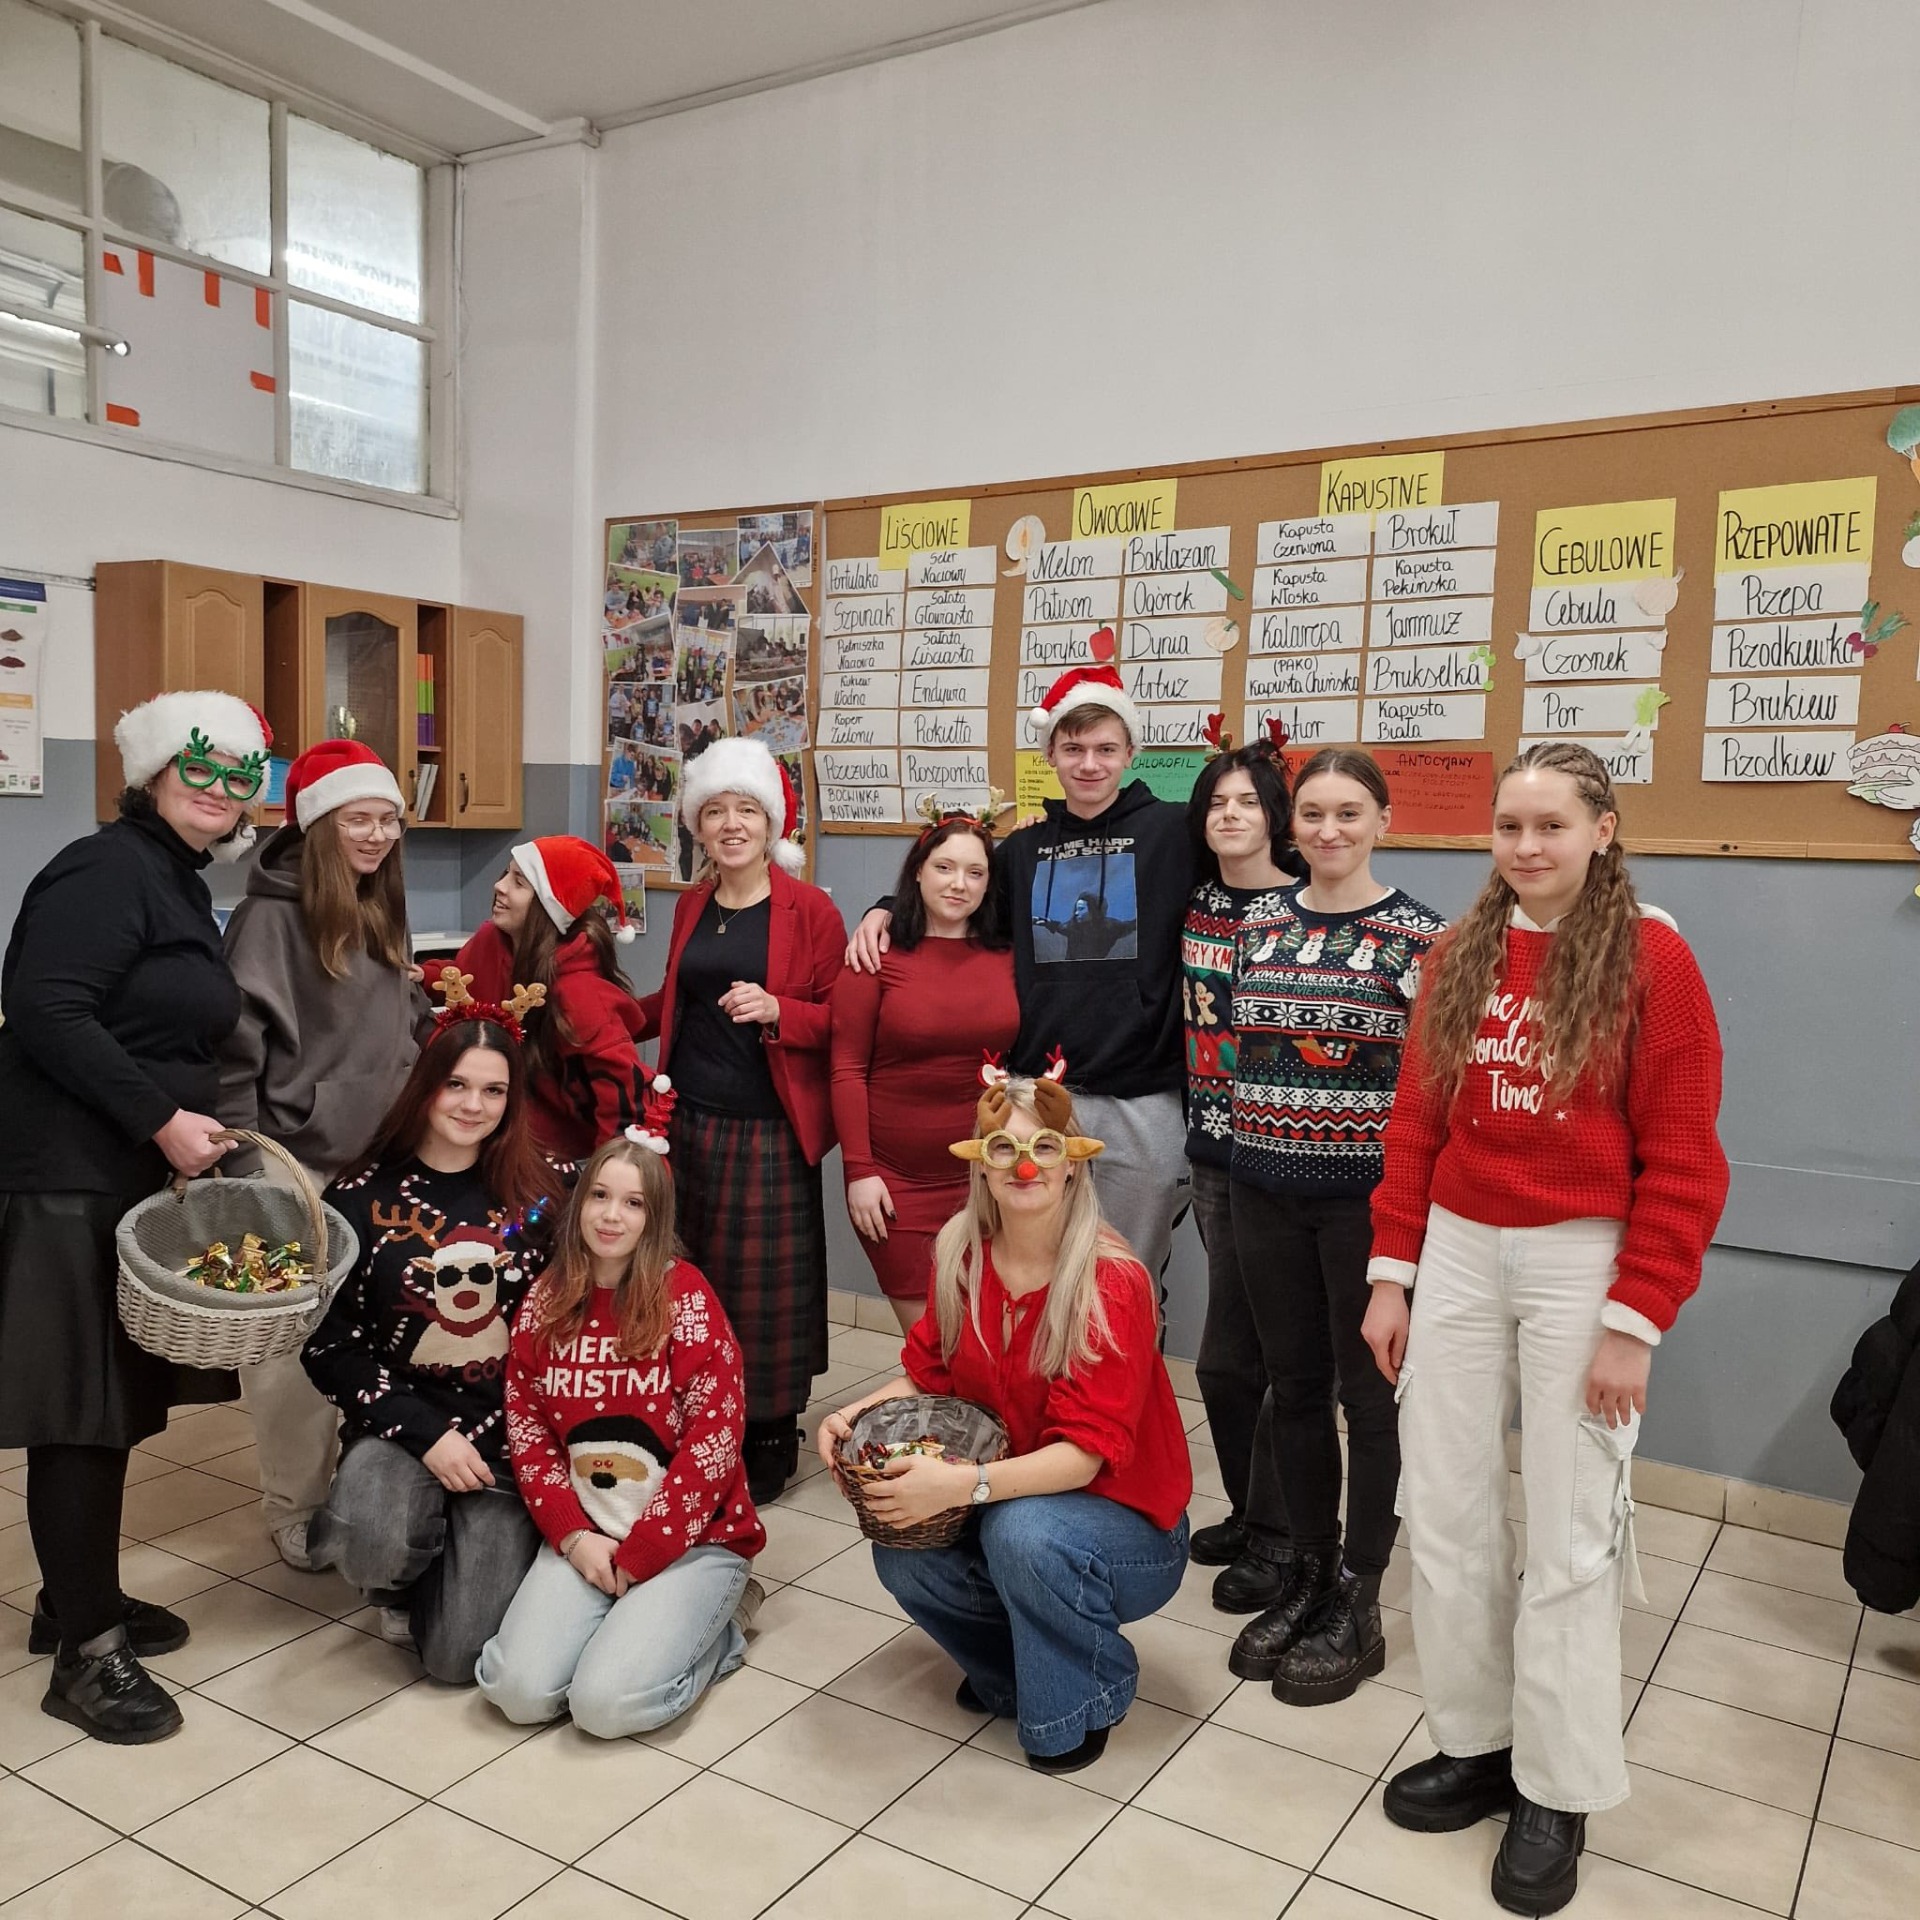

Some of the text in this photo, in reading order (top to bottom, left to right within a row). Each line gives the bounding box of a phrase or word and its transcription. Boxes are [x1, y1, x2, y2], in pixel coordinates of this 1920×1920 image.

[1326, 470, 1429, 514] KAPUSTNE
[1078, 492, 1163, 537] OWOCOWE
[1279, 518, 1335, 541] Kapusta
[1388, 509, 1461, 551] Brokuł
[1273, 539, 1337, 559] Czerwona
[1539, 527, 1664, 576] CEBULOWE
[1723, 510, 1861, 560] RZEPOWATE
[829, 562, 879, 590] Portulaka
[1032, 545, 1095, 580] Melon
[1272, 566, 1328, 588] Kapusta
[1395, 557, 1454, 579] Kapusta
[1134, 581, 1196, 616] Ogórek
[1271, 588, 1320, 606] Włoska
[1383, 574, 1459, 598] Pekińska
[1741, 575, 1824, 616] Rzepa
[833, 598, 896, 632] Szpinak
[1029, 586, 1094, 622] Patison
[1545, 587, 1618, 627] Cebula
[1026, 630, 1088, 665] Papryka
[1128, 623, 1191, 661] Dynia
[1542, 636, 1629, 675] Czosnek
[1727, 622, 1856, 669] Rzodkiewka
[1130, 665, 1189, 699] Arbuz
[1249, 674, 1304, 699] Kapusta
[1373, 652, 1482, 691] Brukselka
[1378, 697, 1447, 720] Kapusta
[1543, 692, 1584, 729] Por
[1729, 678, 1839, 725] Brukiew
[1377, 717, 1423, 741] Biała
[906, 754, 987, 787] Roszponka
[1131, 757, 1197, 770] CHLOROFIL
[1396, 753, 1474, 771] ANTOCYJANY
[1721, 735, 1837, 778] Rzodkiew
[829, 804, 884, 821] BOTWINKA
[1063, 839, 1085, 850] ME
[1243, 981, 1288, 994] XMAS
[1291, 983, 1347, 998] MERRY
[1250, 970, 1295, 982] XMAS
[1297, 972, 1353, 985] MERRY
[1487, 1070, 1544, 1115] Time
